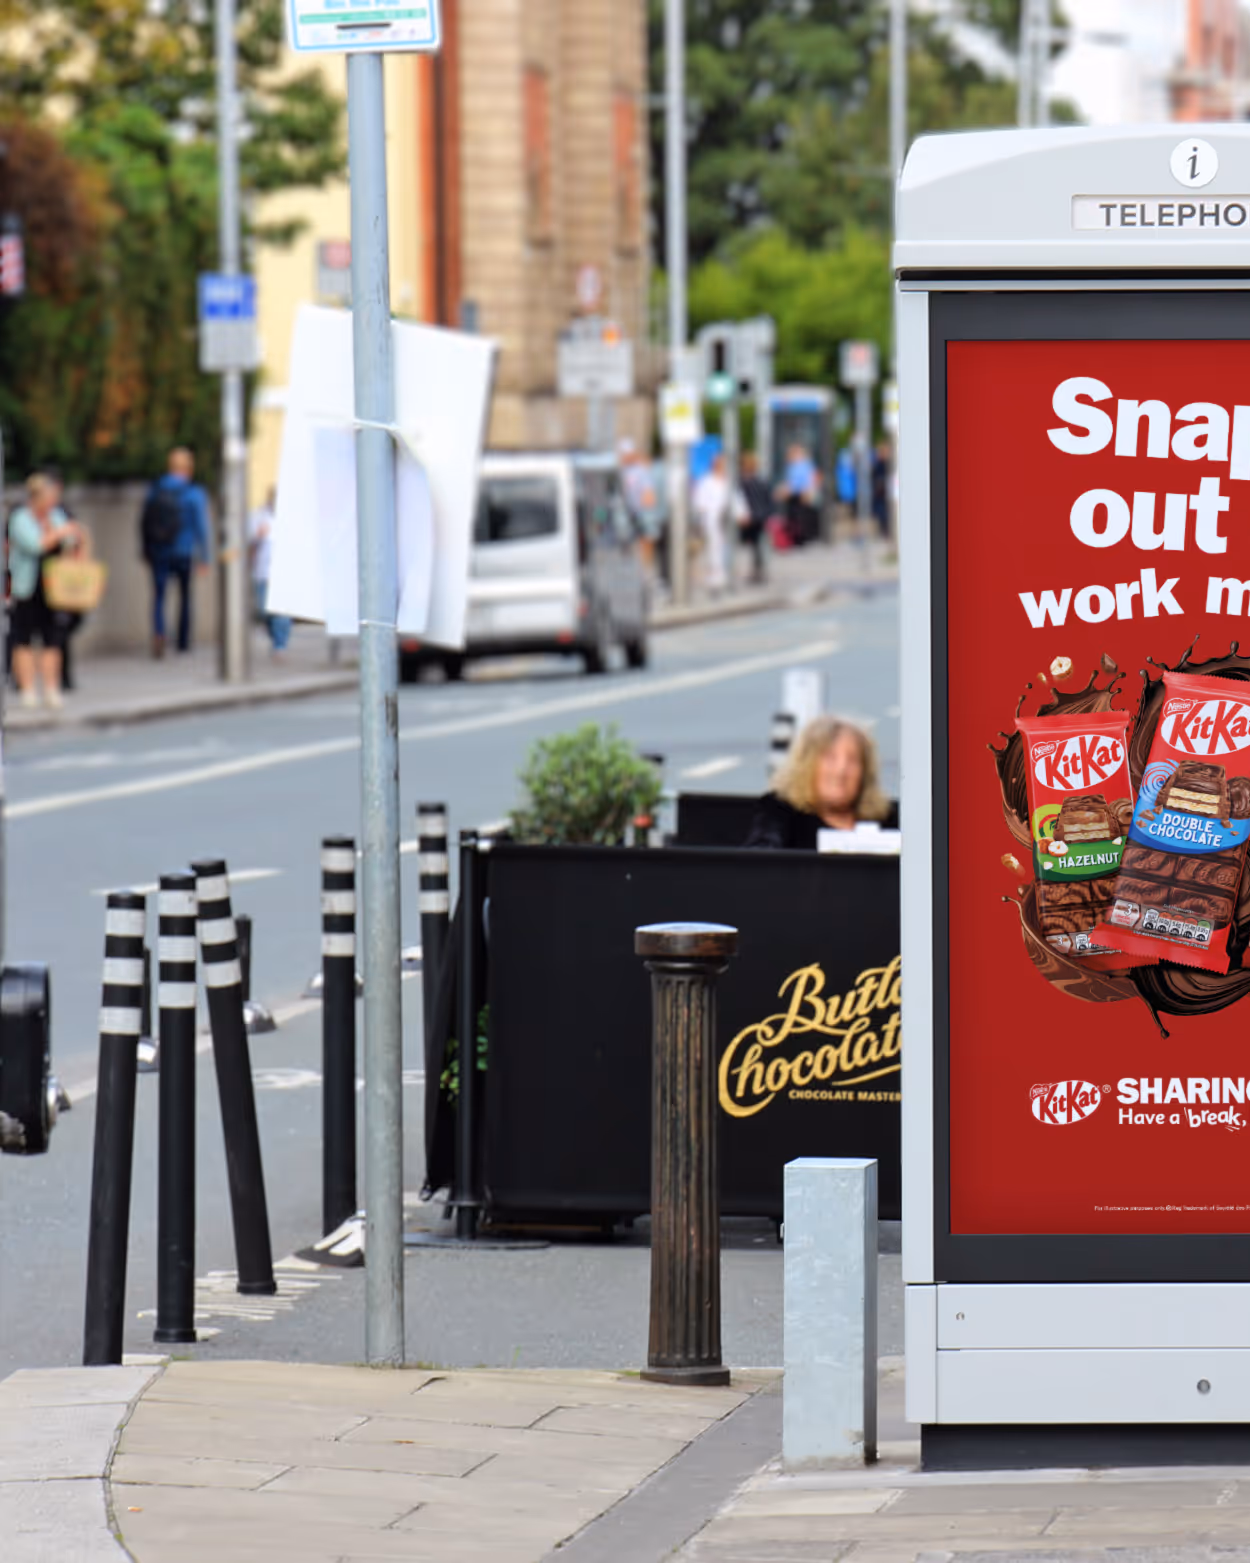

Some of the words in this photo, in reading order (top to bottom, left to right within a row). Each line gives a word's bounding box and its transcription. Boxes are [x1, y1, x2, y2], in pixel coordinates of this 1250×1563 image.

[1070, 477, 1230, 554] out
[1019, 568, 1184, 628] work
[1044, 735, 1122, 790] KitKat
[1149, 823, 1223, 848] CHOCOLATE
[1162, 813, 1215, 833] DOUBLE
[1058, 852, 1120, 869] HAZELNUT
[788, 1089, 854, 1101] CHOCOLATE
[1039, 1081, 1098, 1124] KitKat
[1118, 1108, 1165, 1125] Have
[1169, 1113, 1180, 1125] a
[1187, 1105, 1247, 1129] break,
